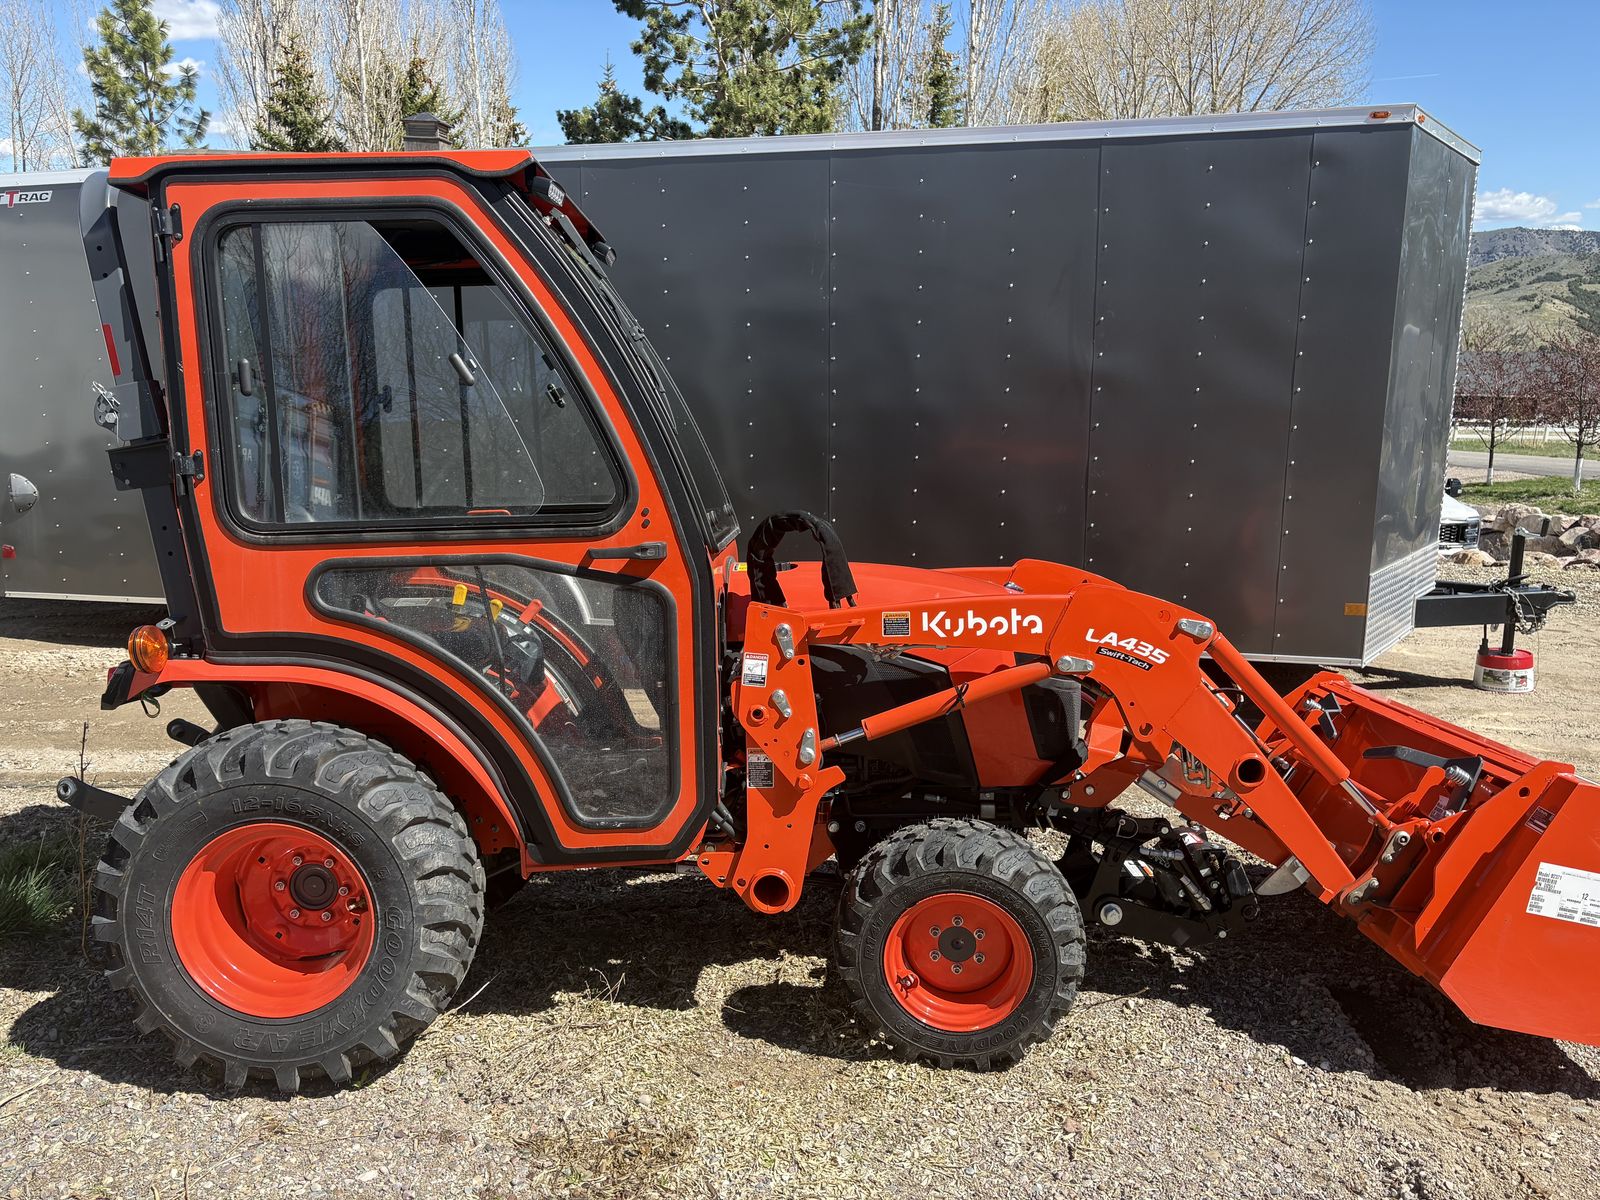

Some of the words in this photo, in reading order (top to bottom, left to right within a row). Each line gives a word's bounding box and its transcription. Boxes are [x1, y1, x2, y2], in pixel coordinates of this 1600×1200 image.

[922, 608, 1043, 638] Kubota
[1085, 628, 1171, 665] LA435
[1099, 648, 1149, 670] Swift-Tach
[135, 884, 163, 965] R14T
[233, 906, 404, 1053] GOODYEAR
